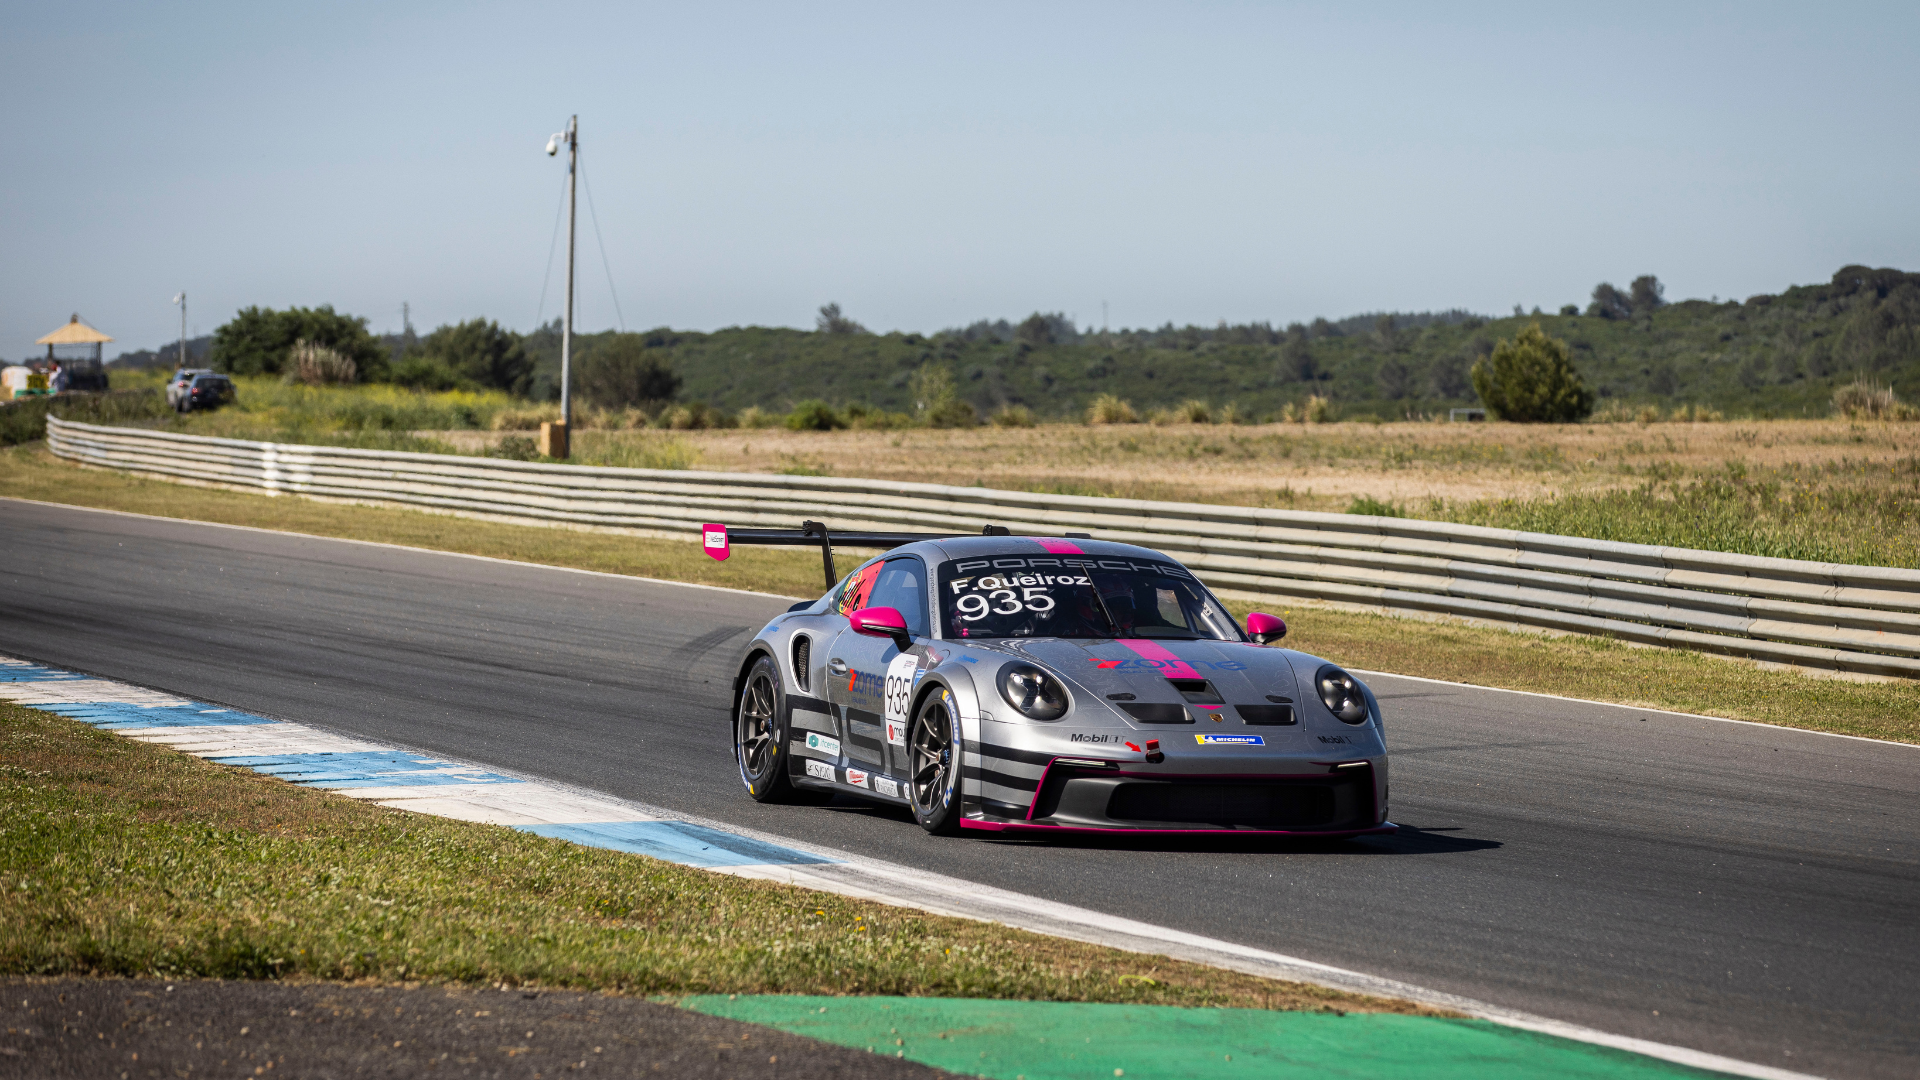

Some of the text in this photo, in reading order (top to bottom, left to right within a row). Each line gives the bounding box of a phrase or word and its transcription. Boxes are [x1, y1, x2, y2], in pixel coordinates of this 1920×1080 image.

[956, 558, 1193, 580] PORSCHE
[951, 573, 1092, 594] F.Queiroz
[956, 587, 1056, 621] 935
[886, 675, 911, 717] 935
[1070, 733, 1109, 743] Mobil
[1317, 735, 1345, 744] Mobil
